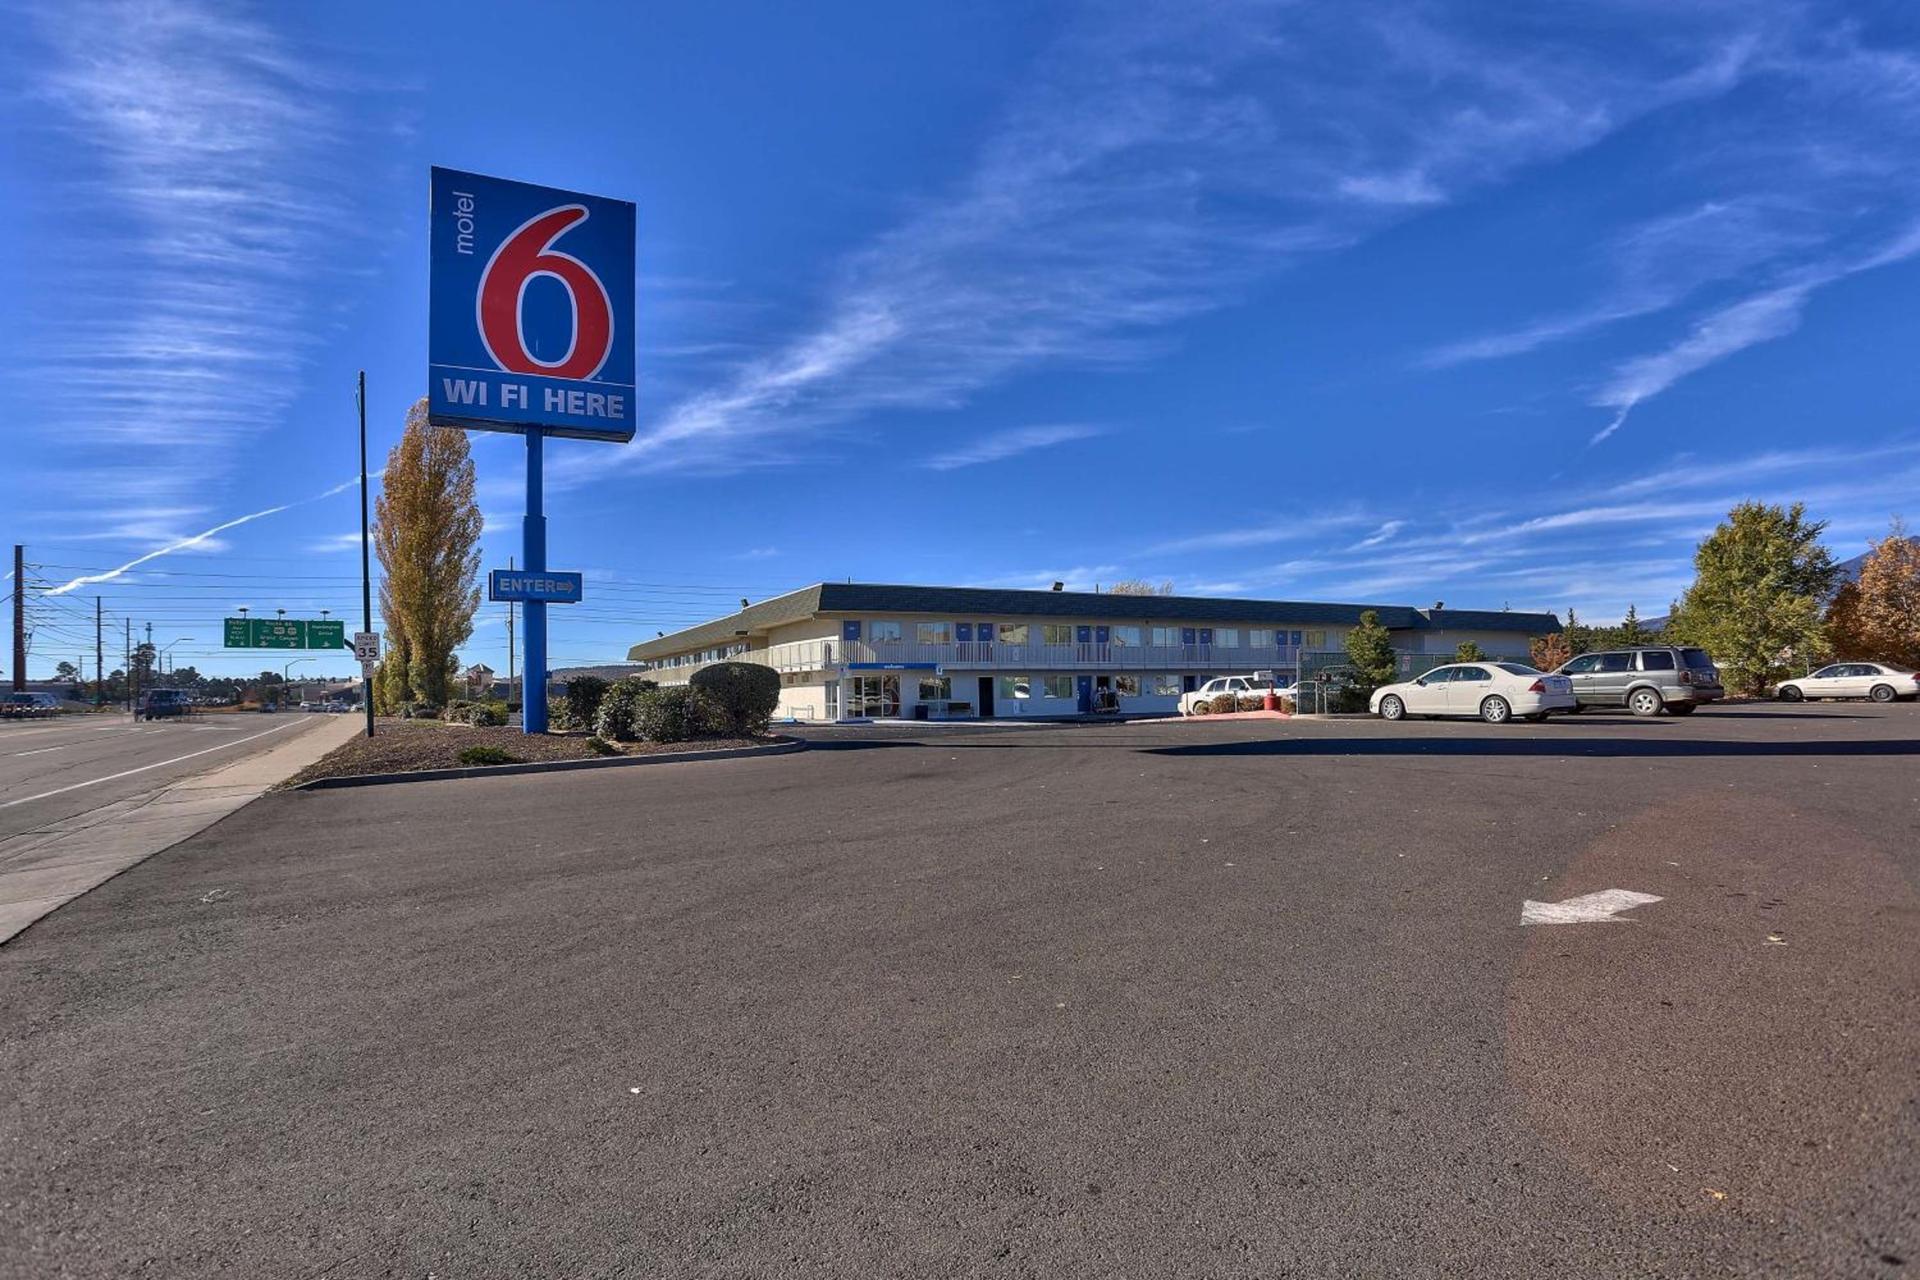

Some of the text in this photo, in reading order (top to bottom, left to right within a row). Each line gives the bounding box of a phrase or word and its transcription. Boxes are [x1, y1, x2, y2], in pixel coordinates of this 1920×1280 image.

[452, 191, 474, 255] motel
[476, 203, 615, 381] 6
[443, 378, 625, 419] WI FI HERE
[500, 577, 556, 592] ENTER
[358, 647, 377, 658] 35
